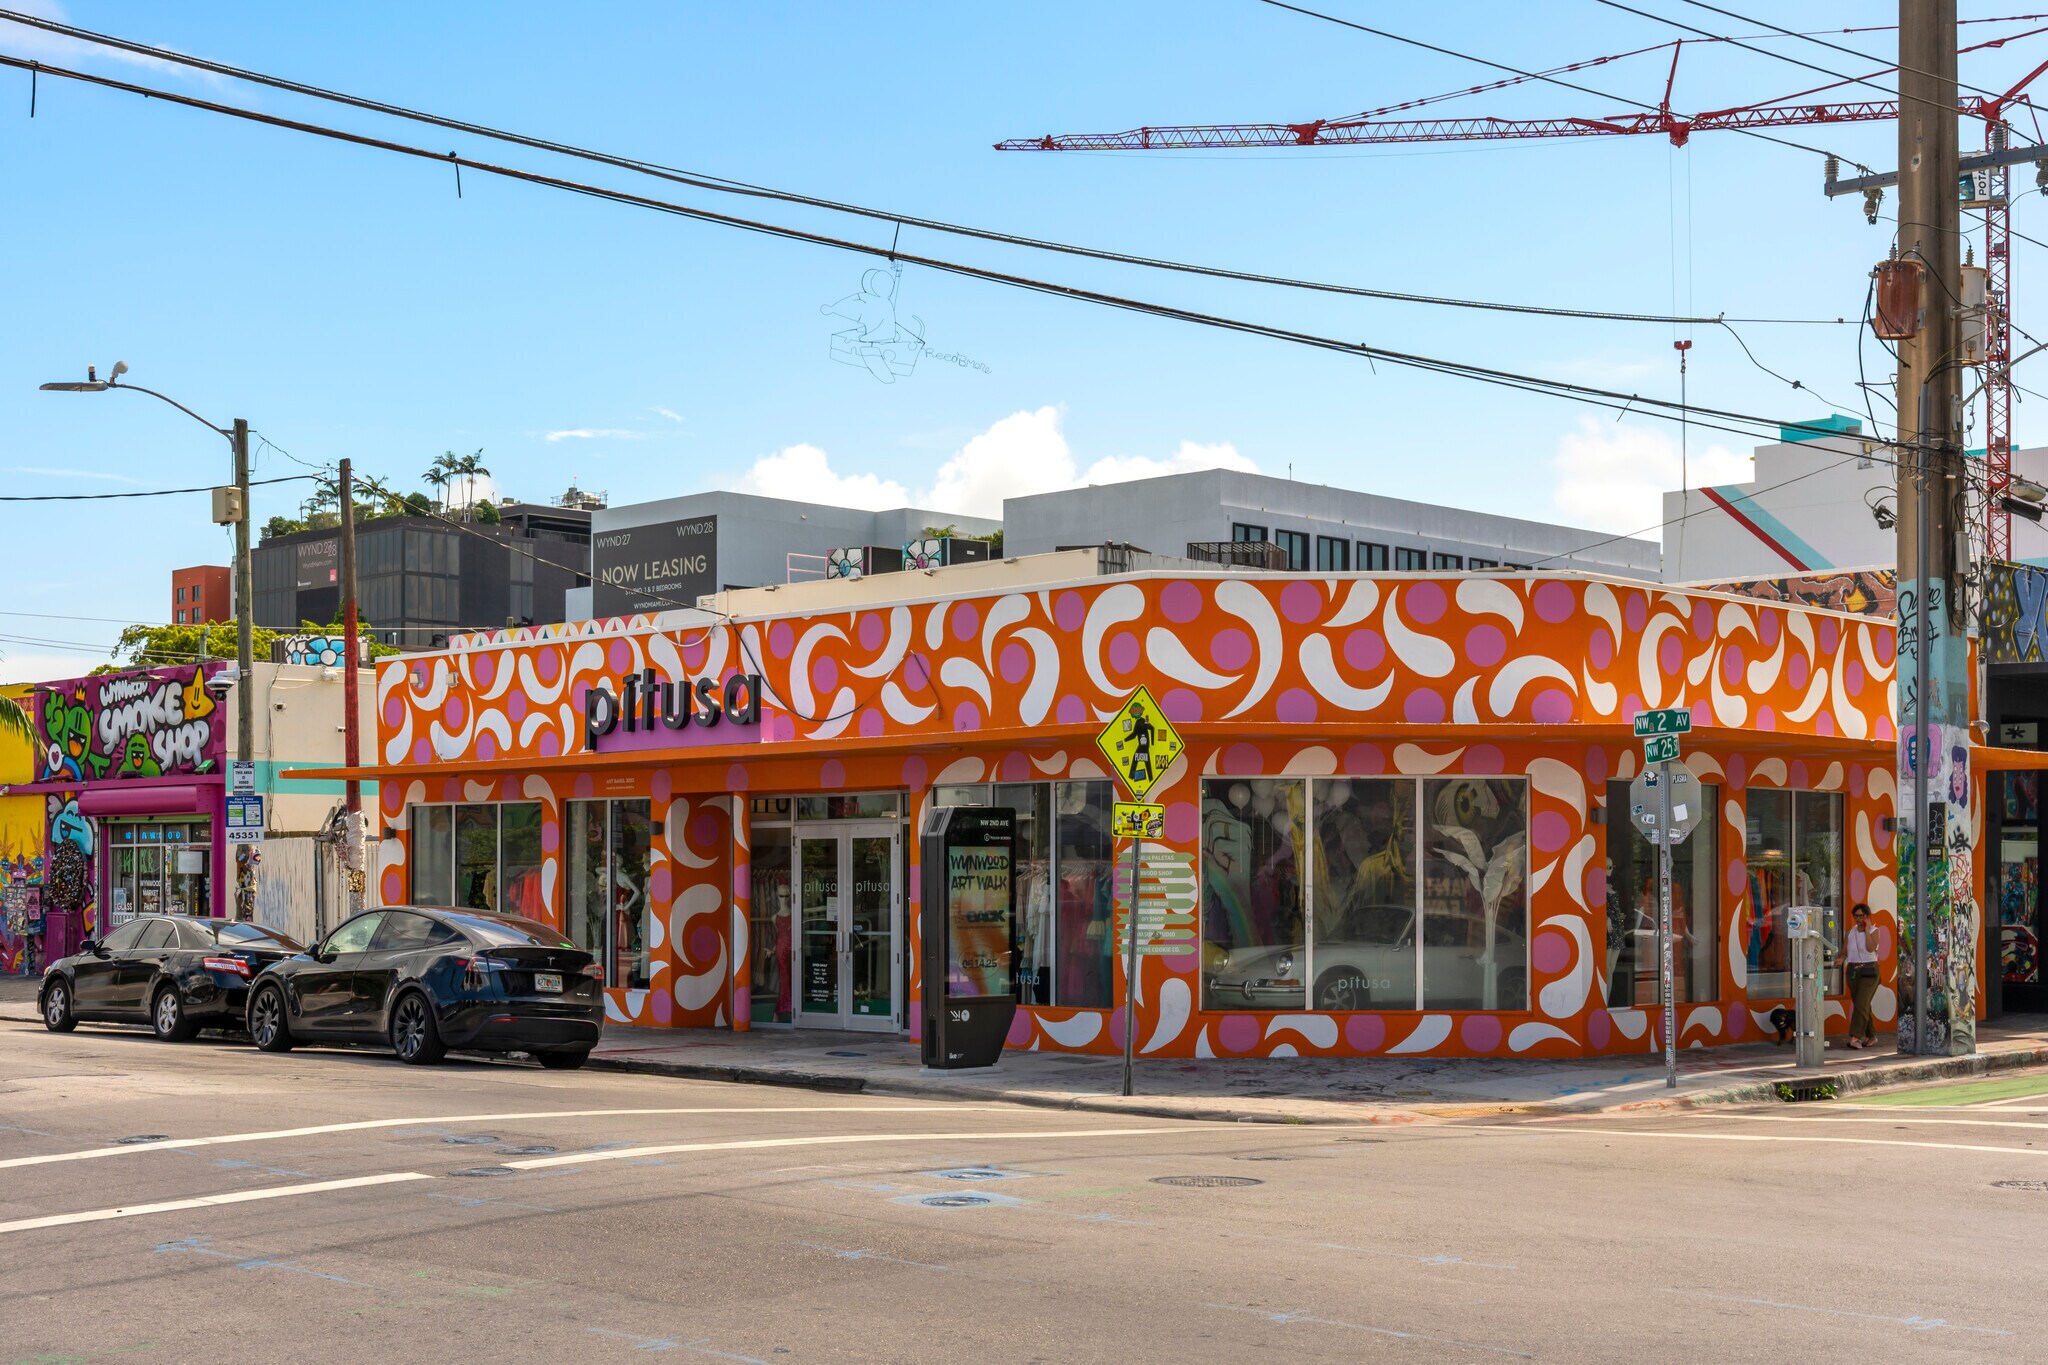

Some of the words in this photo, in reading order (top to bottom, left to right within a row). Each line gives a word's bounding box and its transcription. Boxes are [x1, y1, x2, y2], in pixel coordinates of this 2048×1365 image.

[602, 564, 638, 584] NOW
[644, 555, 706, 580] LEASING
[656, 582, 682, 592] BEDROOMS
[99, 682, 183, 754] SMOKE
[1636, 718, 1649, 730] NW
[1657, 712, 1667, 732] 2
[1676, 714, 1688, 726] AV
[153, 720, 210, 772] SHOP
[1647, 744, 1659, 758] NW
[1661, 738, 1673, 758] 25
[950, 855, 1009, 874] WYNWOOD
[951, 876, 975, 891] ART
[977, 876, 1007, 891] WALK
[966, 910, 1005, 922] BACK
[1016, 972, 1040, 984] tusa
